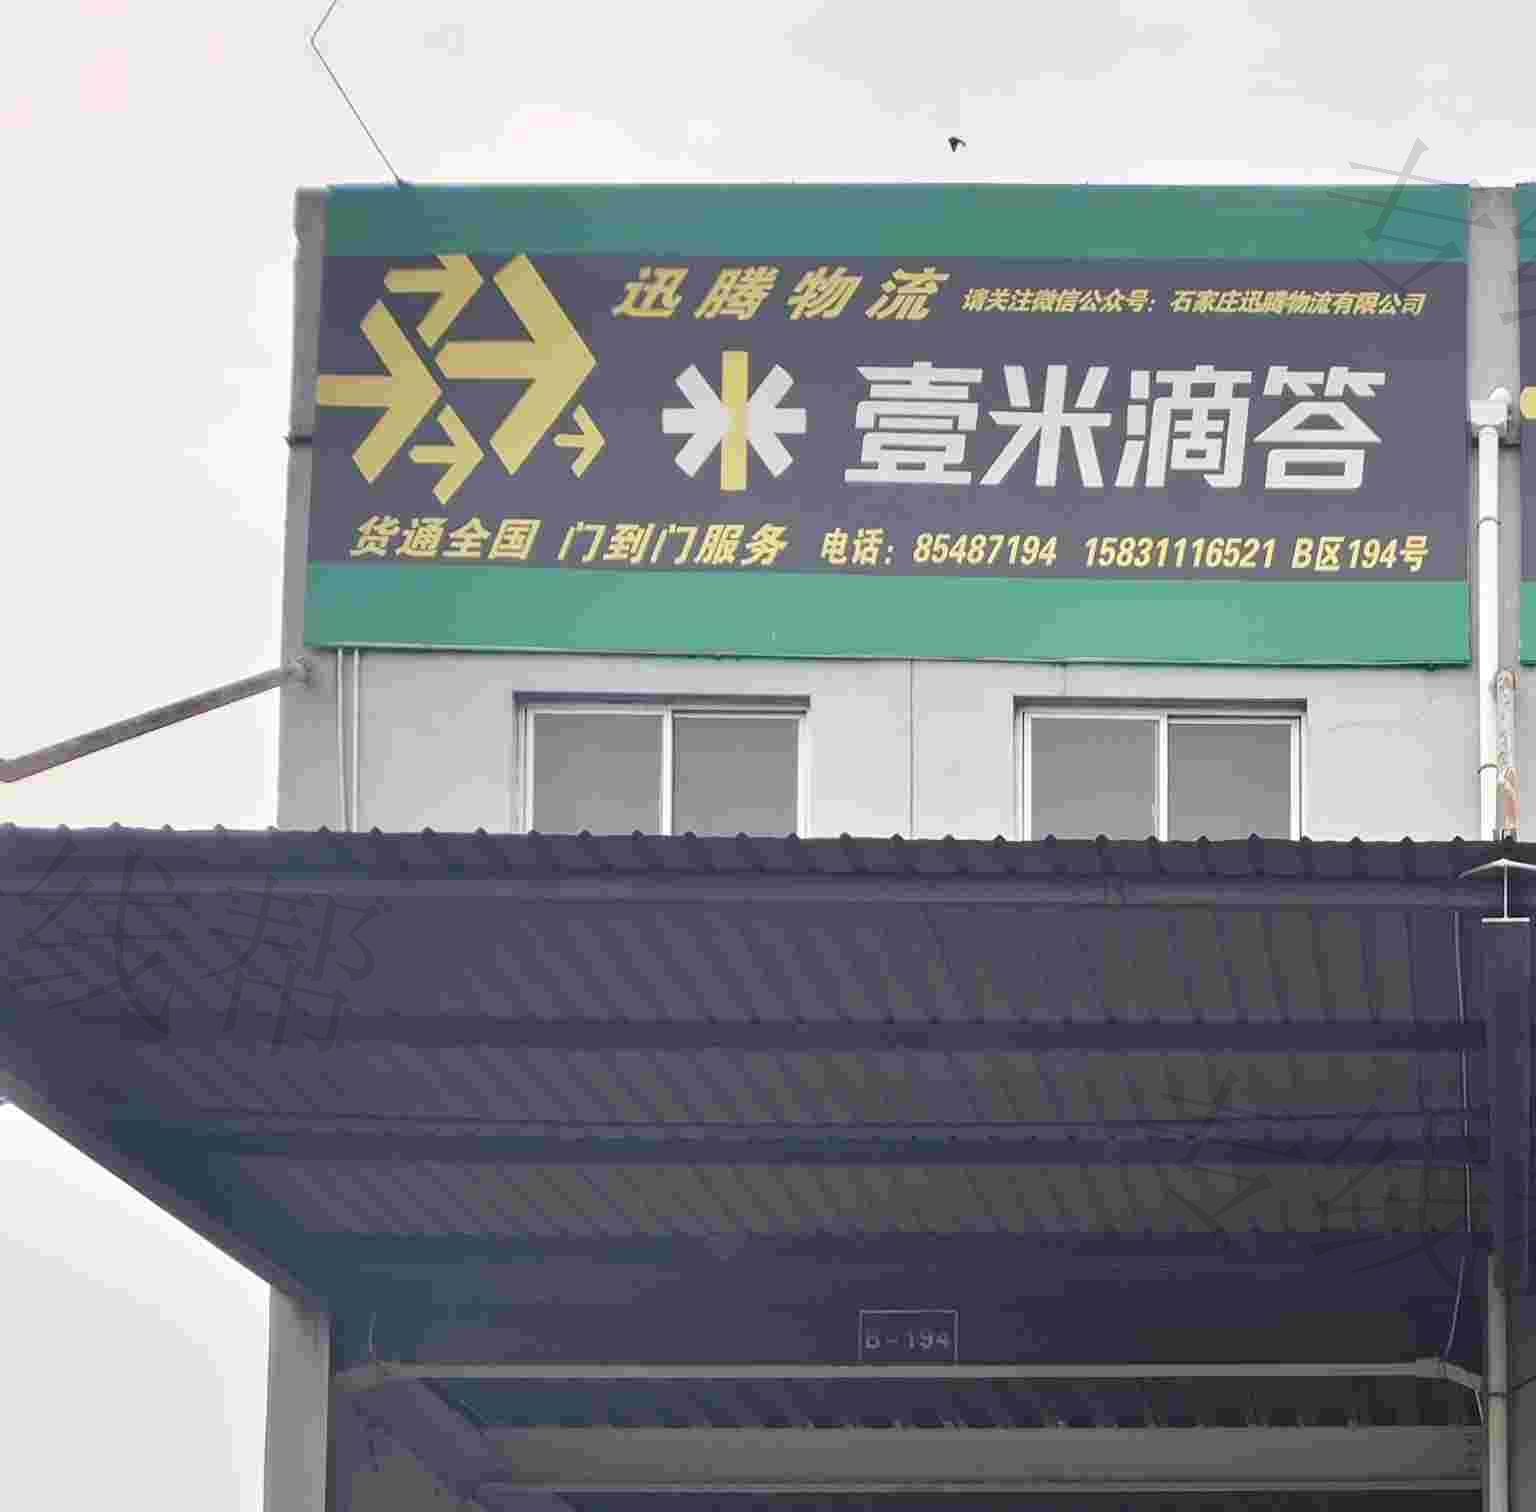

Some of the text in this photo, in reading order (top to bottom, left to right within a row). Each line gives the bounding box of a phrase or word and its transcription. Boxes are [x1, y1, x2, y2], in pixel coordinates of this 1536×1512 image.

[612, 266, 950, 320] 迅腾物流
[844, 361, 1386, 489] 壹米滴答
[350, 516, 541, 560] 货通全国
[557, 521, 789, 566] 门到门服务
[1085, 536, 1276, 569] 15831116521
[1291, 535, 1429, 573] B区194号
